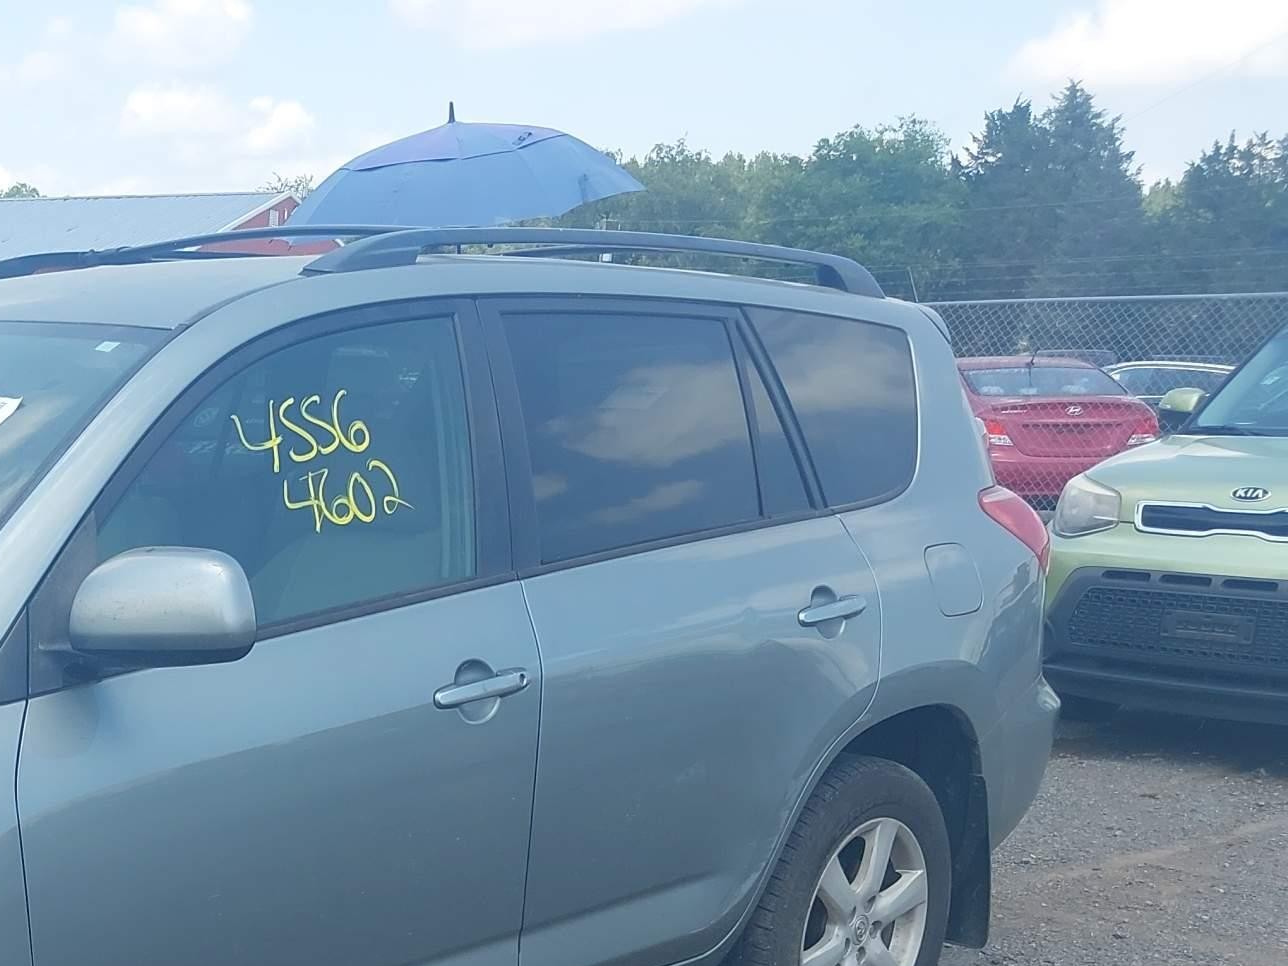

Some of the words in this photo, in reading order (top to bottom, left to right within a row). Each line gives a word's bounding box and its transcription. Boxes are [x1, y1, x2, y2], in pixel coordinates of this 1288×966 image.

[230, 389, 370, 472] 4556
[283, 459, 415, 533] 4602
[1235, 489, 1263, 498] KIA
